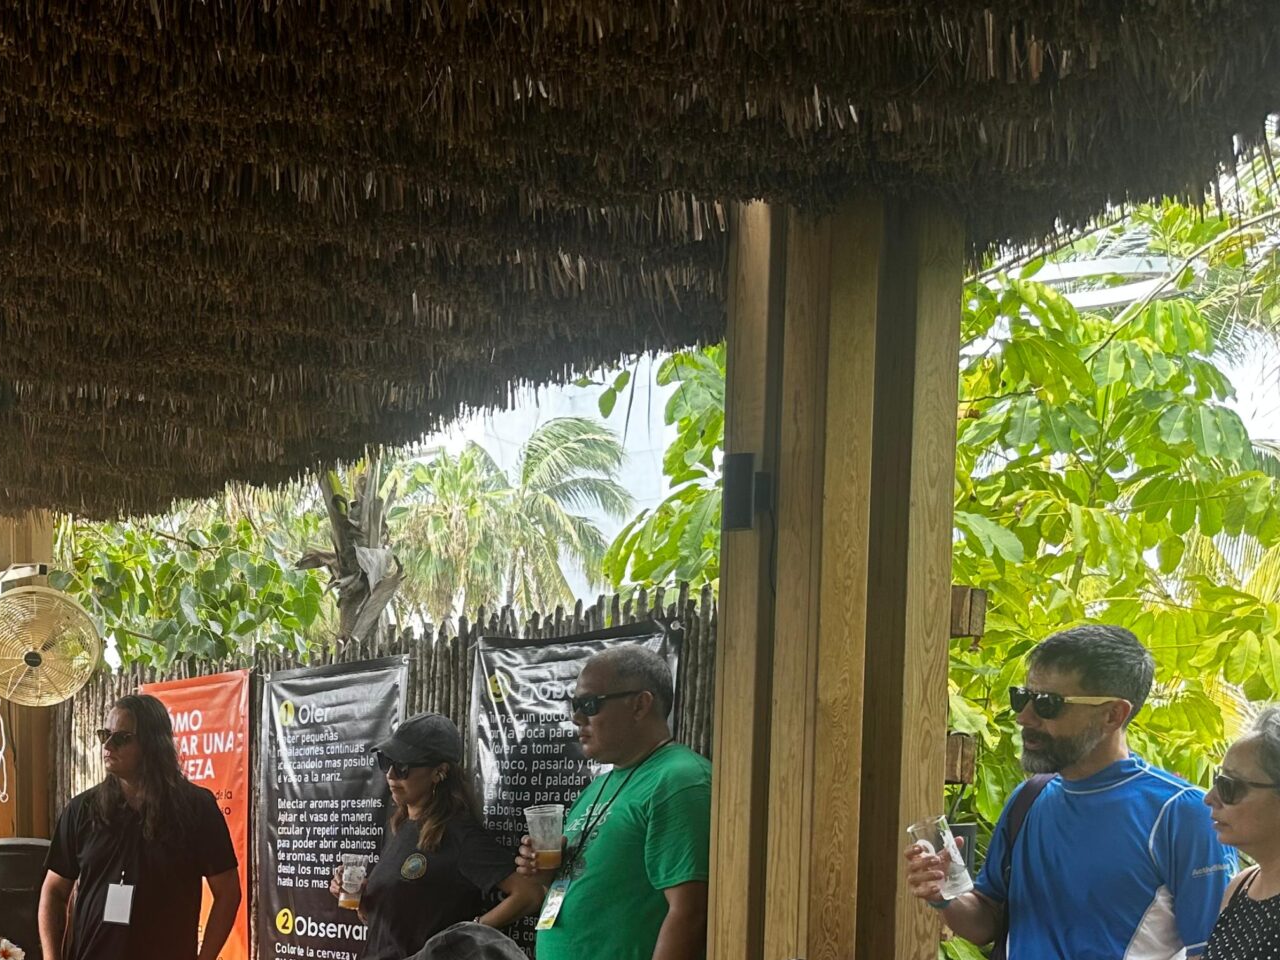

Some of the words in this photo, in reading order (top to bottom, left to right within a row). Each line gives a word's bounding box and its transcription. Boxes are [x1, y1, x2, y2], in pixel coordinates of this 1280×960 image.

[168, 707, 202, 733] ÓMO
[298, 703, 331, 725] Oler
[522, 713, 536, 722] un
[540, 713, 566, 726] poco
[301, 730, 338, 746] pequeñas
[549, 728, 574, 741] para
[203, 731, 234, 755] UNA
[326, 742, 365, 754] continuas
[520, 744, 528, 754] a
[532, 742, 566, 754] tomar
[324, 759, 342, 768] mas
[343, 756, 374, 770] posible
[532, 757, 574, 773] pasarlo
[577, 761, 584, 773] y
[304, 774, 309, 782] a
[312, 771, 319, 782] la
[322, 770, 342, 782] nariz.
[530, 773, 542, 786] el
[546, 773, 586, 789] paladar
[534, 790, 560, 804] para
[310, 800, 339, 808] aromas
[340, 798, 384, 811] presentes.
[300, 812, 307, 822] el
[310, 814, 328, 822] vaso
[330, 812, 339, 822] de
[341, 812, 372, 822] manera
[306, 827, 311, 840] y
[312, 825, 339, 838] repetir
[341, 822, 384, 836] inhalación
[292, 838, 317, 852] poder
[319, 838, 338, 849] abrir
[340, 839, 376, 850] abanicos
[320, 854, 334, 864] que
[298, 864, 311, 874] los
[314, 867, 330, 875] mas
[296, 876, 309, 888] los
[312, 880, 328, 888] mas
[294, 916, 368, 940] Observar
[306, 946, 314, 957] la
[316, 949, 350, 960] cerveza
